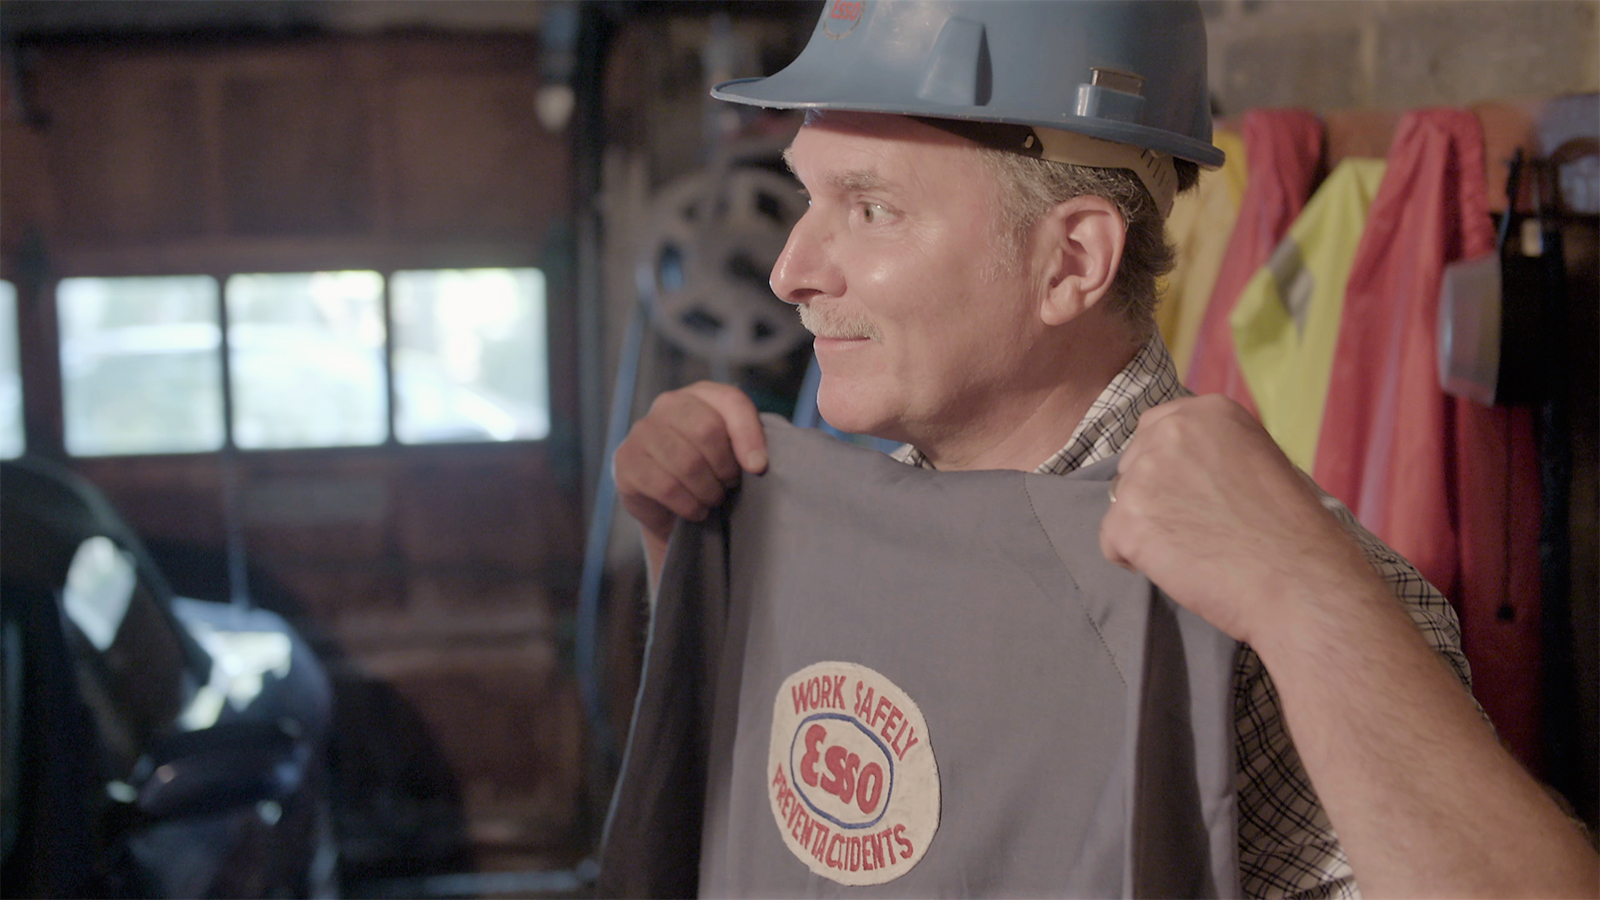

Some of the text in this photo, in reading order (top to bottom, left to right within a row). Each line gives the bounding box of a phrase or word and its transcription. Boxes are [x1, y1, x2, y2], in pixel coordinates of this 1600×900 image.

[791, 675, 919, 762] WORK SAFELY
[772, 762, 826, 856] PREVENT
